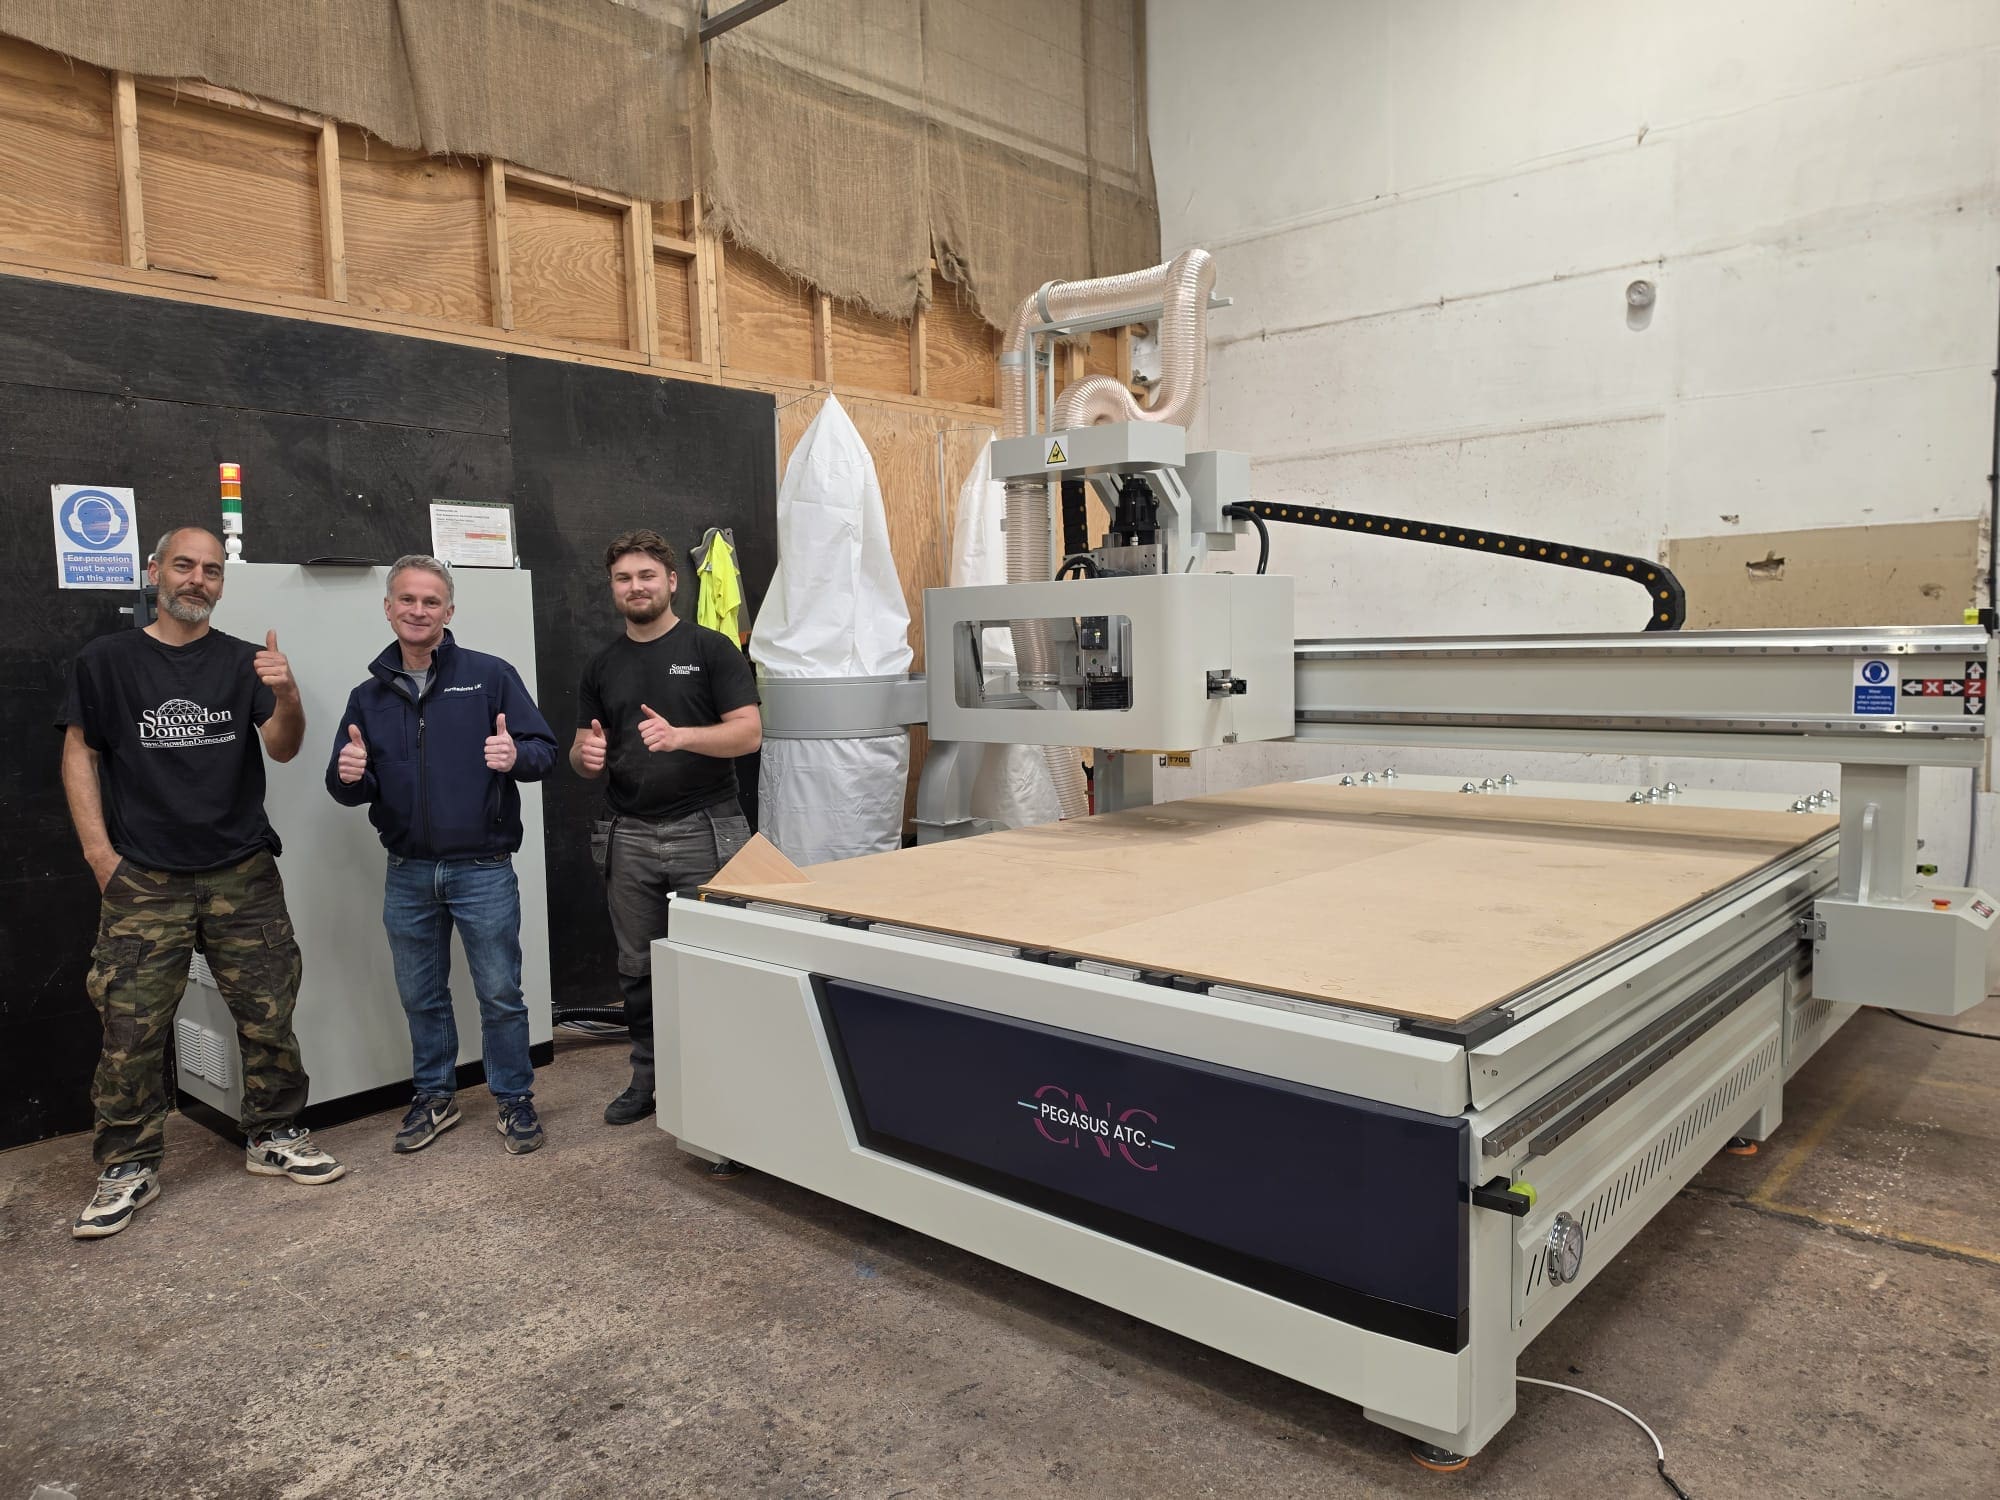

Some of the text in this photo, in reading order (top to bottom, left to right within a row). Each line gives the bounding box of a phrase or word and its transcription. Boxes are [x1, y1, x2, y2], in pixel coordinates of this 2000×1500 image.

[67, 554, 130, 564] Ear protection
[70, 564, 92, 572] must
[94, 564, 105, 572] be
[1926, 682, 1982, 694] X Z
[142, 707, 233, 729] Snowdon
[137, 722, 205, 739] Domes
[1033, 1085, 1158, 1172] CNC
[1041, 1102, 1151, 1149] PEGASUS ATC.
